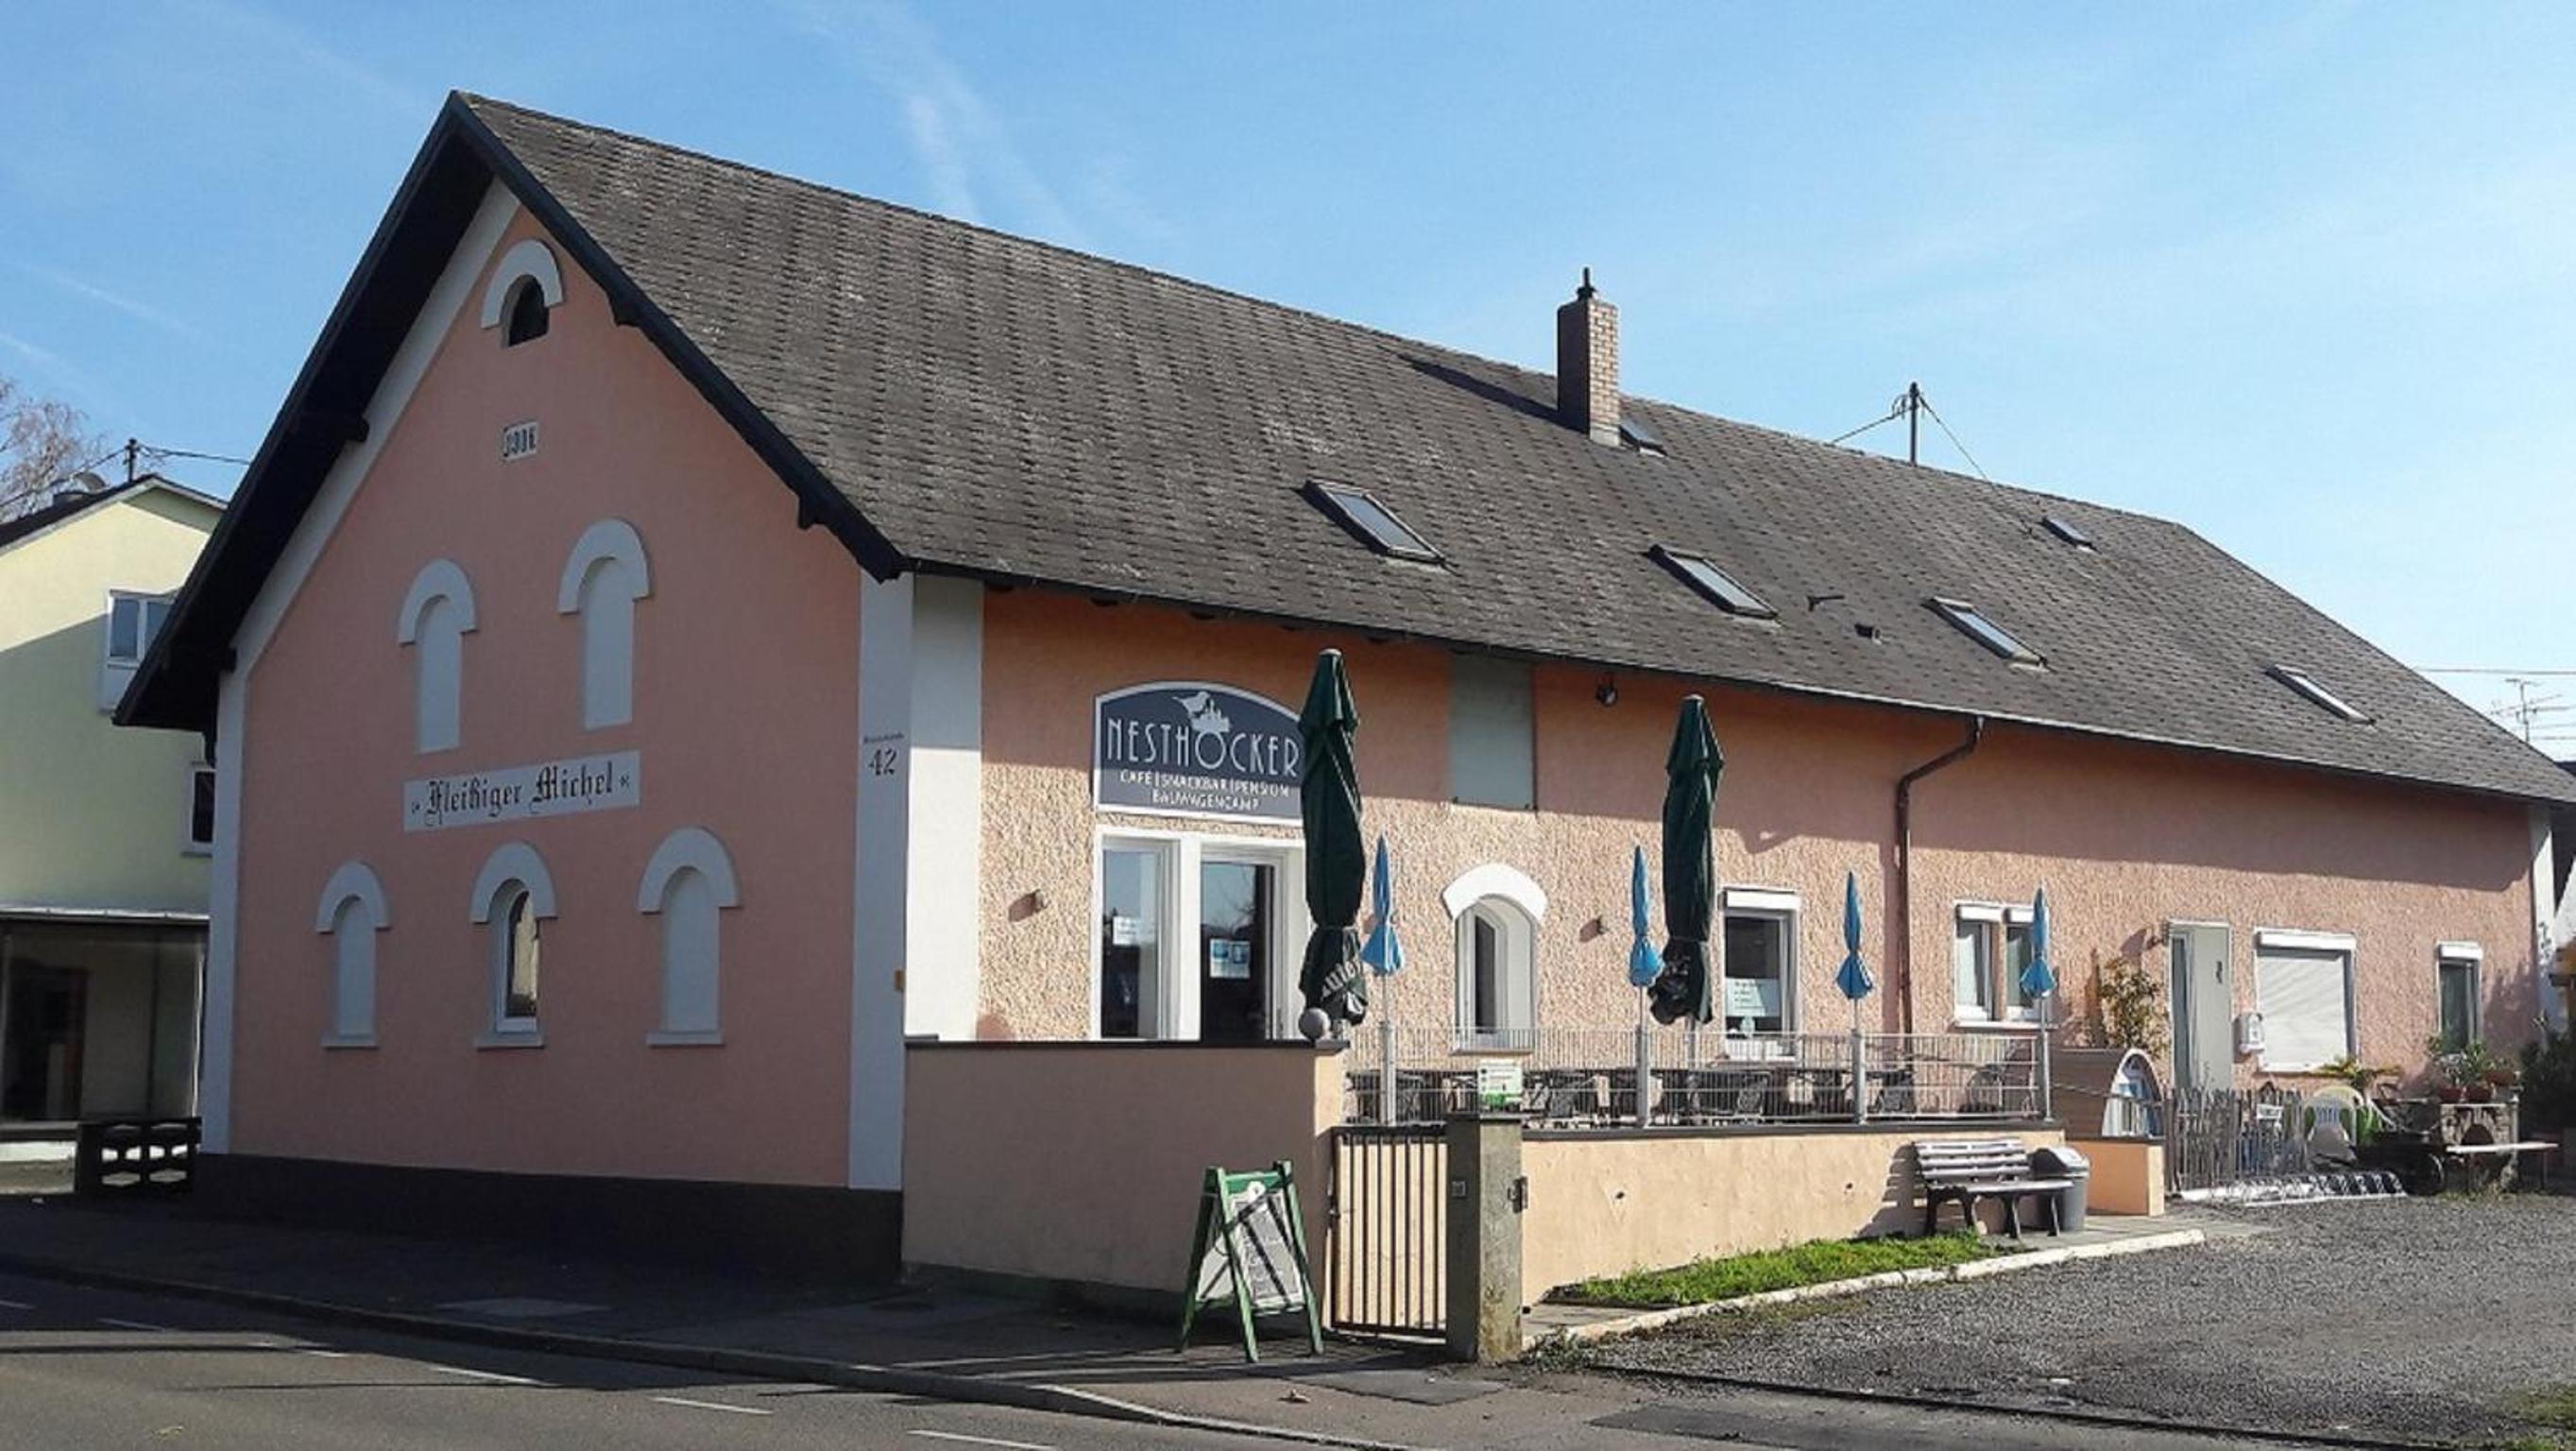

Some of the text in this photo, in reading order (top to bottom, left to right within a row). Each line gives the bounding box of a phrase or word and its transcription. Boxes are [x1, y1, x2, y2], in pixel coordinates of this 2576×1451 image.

[868, 749, 896, 776] 42
[1107, 717, 1301, 777] NESTHOCKER
[529, 760, 613, 814] Michel
